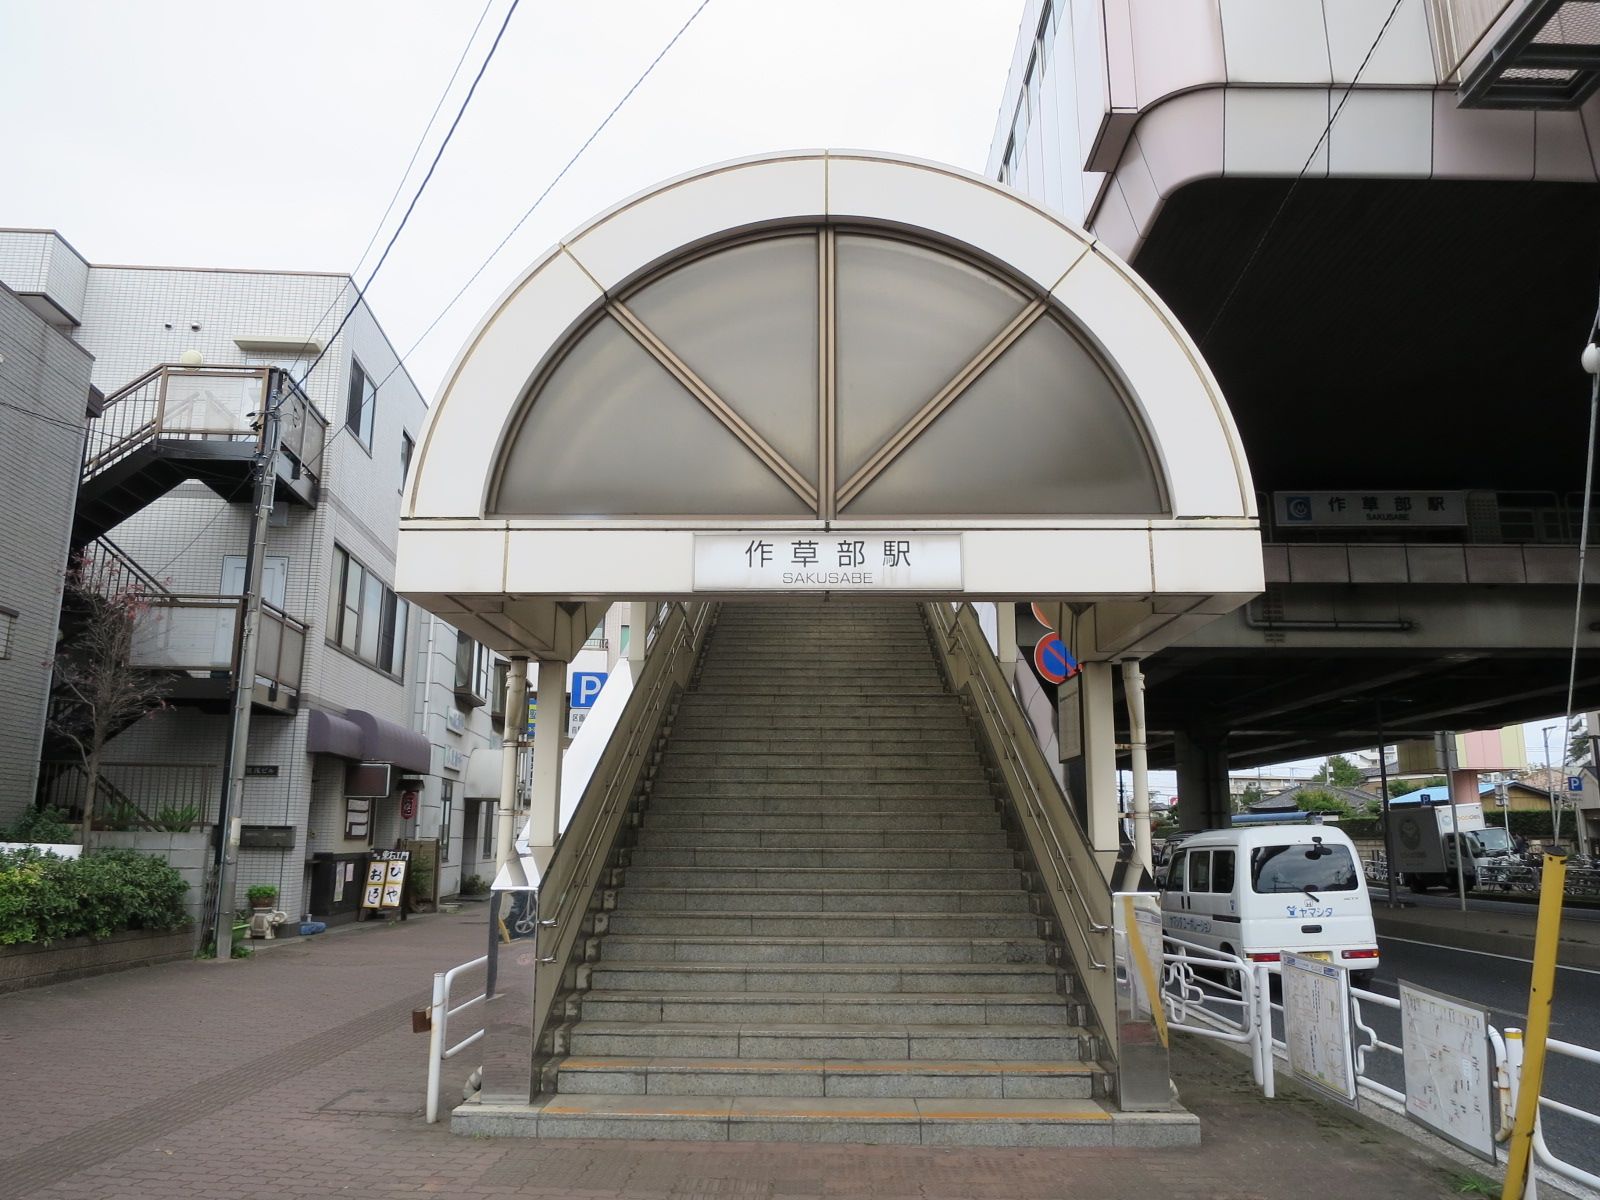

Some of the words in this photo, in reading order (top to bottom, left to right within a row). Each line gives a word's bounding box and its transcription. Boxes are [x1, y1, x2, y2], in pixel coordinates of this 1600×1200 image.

[1328, 496, 1445, 512] 作草部駅
[1366, 513, 1410, 521] SAKUSABE
[745, 540, 911, 568] 作草部駅
[782, 572, 873, 584] SAKUSABE
[580, 676, 601, 704] P
[1571, 778, 1580, 790] P
[1299, 907, 1333, 918] ヤマシタ
